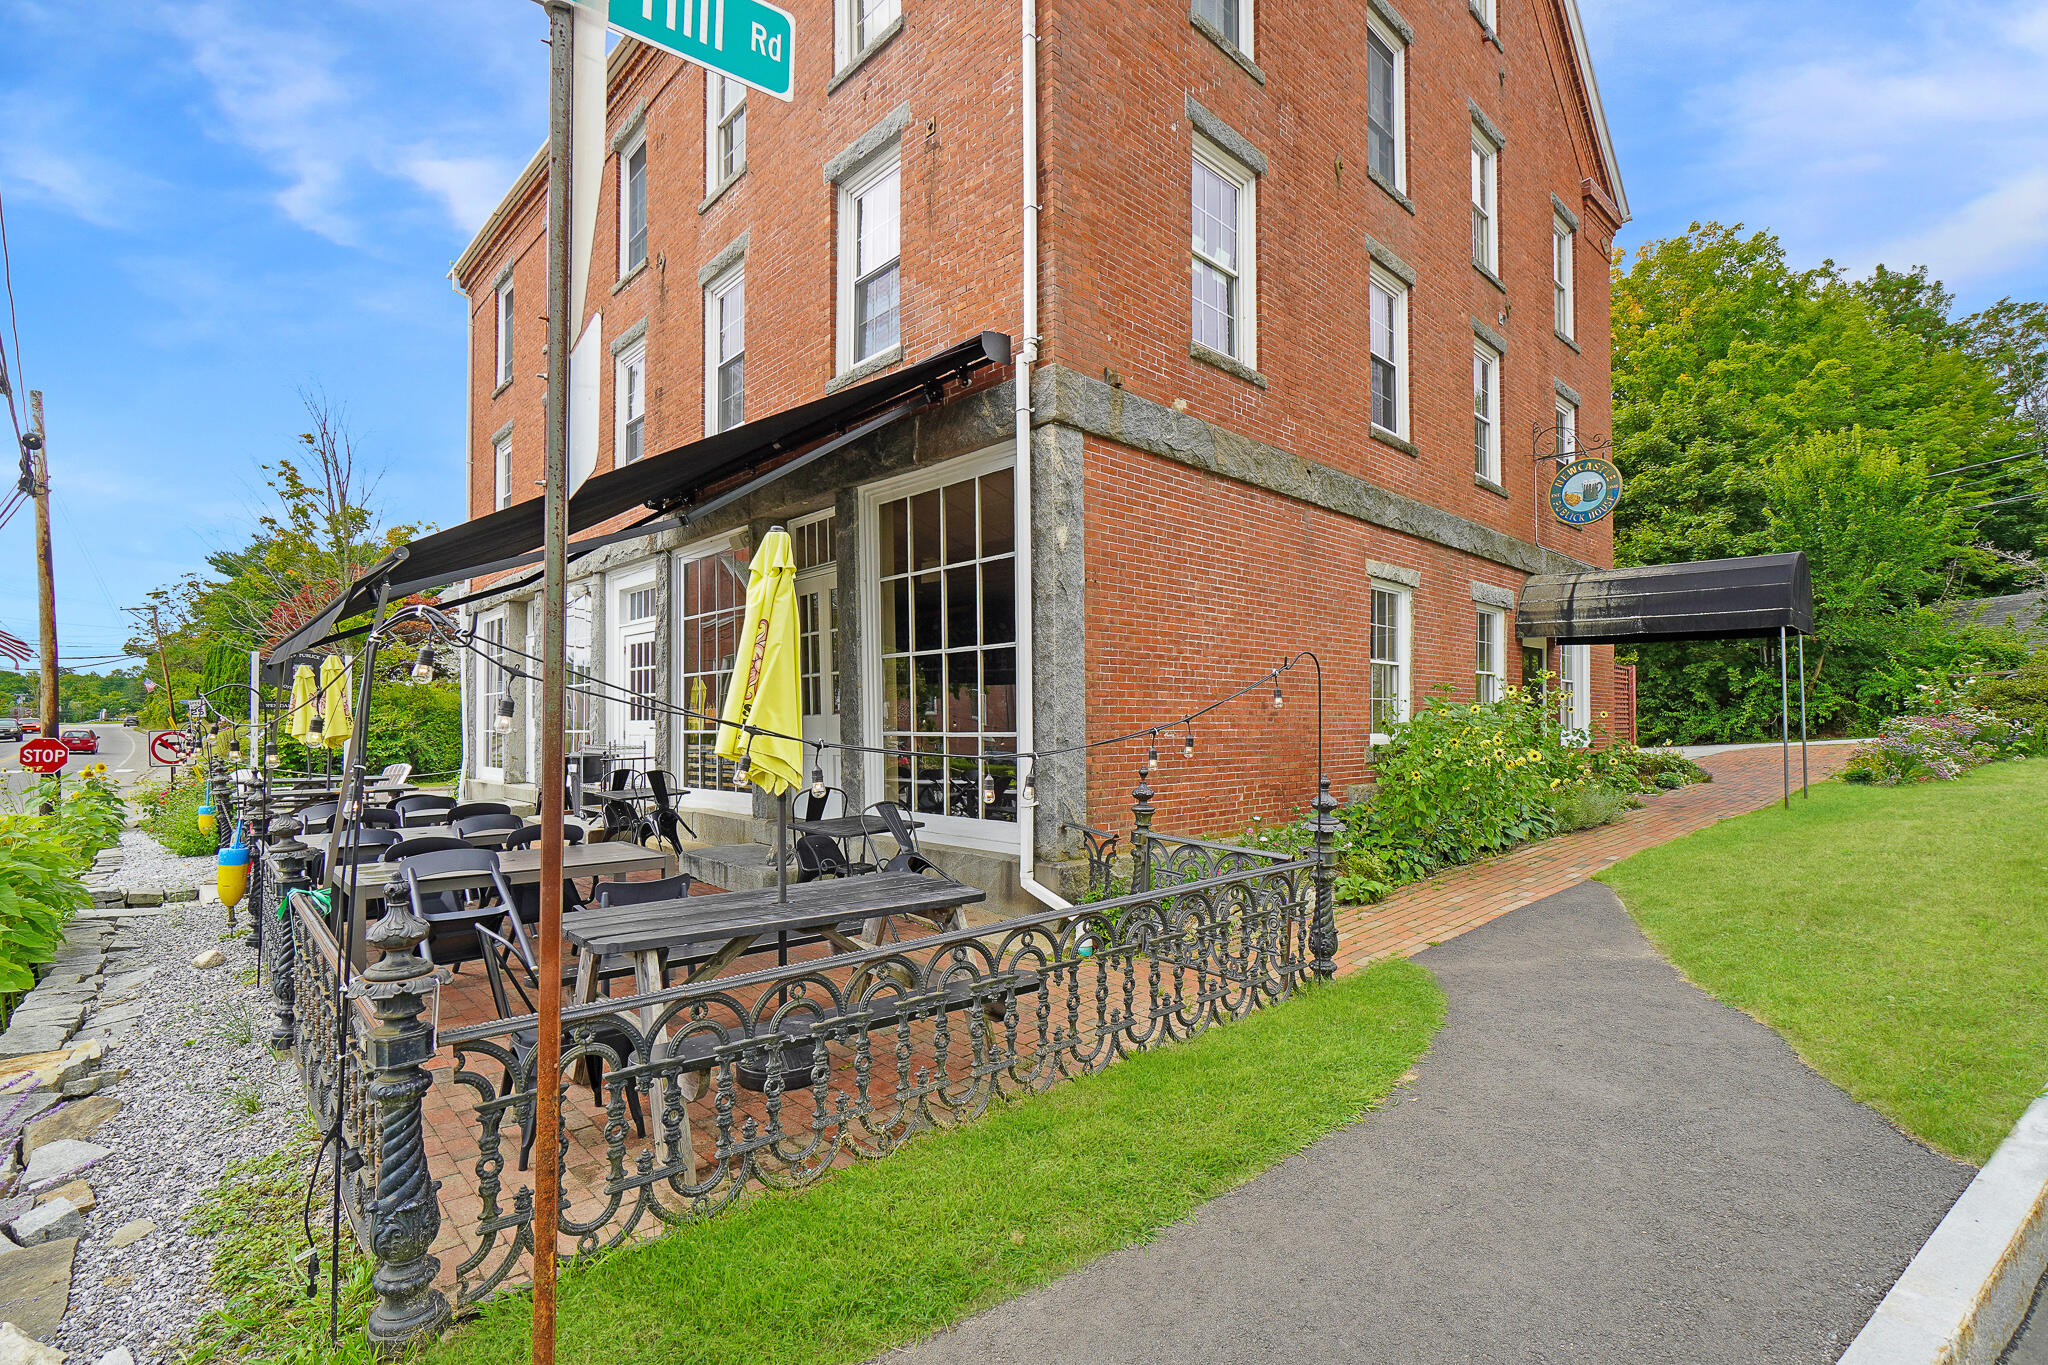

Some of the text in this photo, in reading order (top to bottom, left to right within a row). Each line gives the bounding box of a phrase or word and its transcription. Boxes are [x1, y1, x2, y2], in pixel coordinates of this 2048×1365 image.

[751, 21, 782, 62] Rd
[1555, 462, 1616, 487] NEWCASTLE
[1552, 495, 1616, 522] PUBLICK HOUSE
[22, 749, 65, 762] STOP
